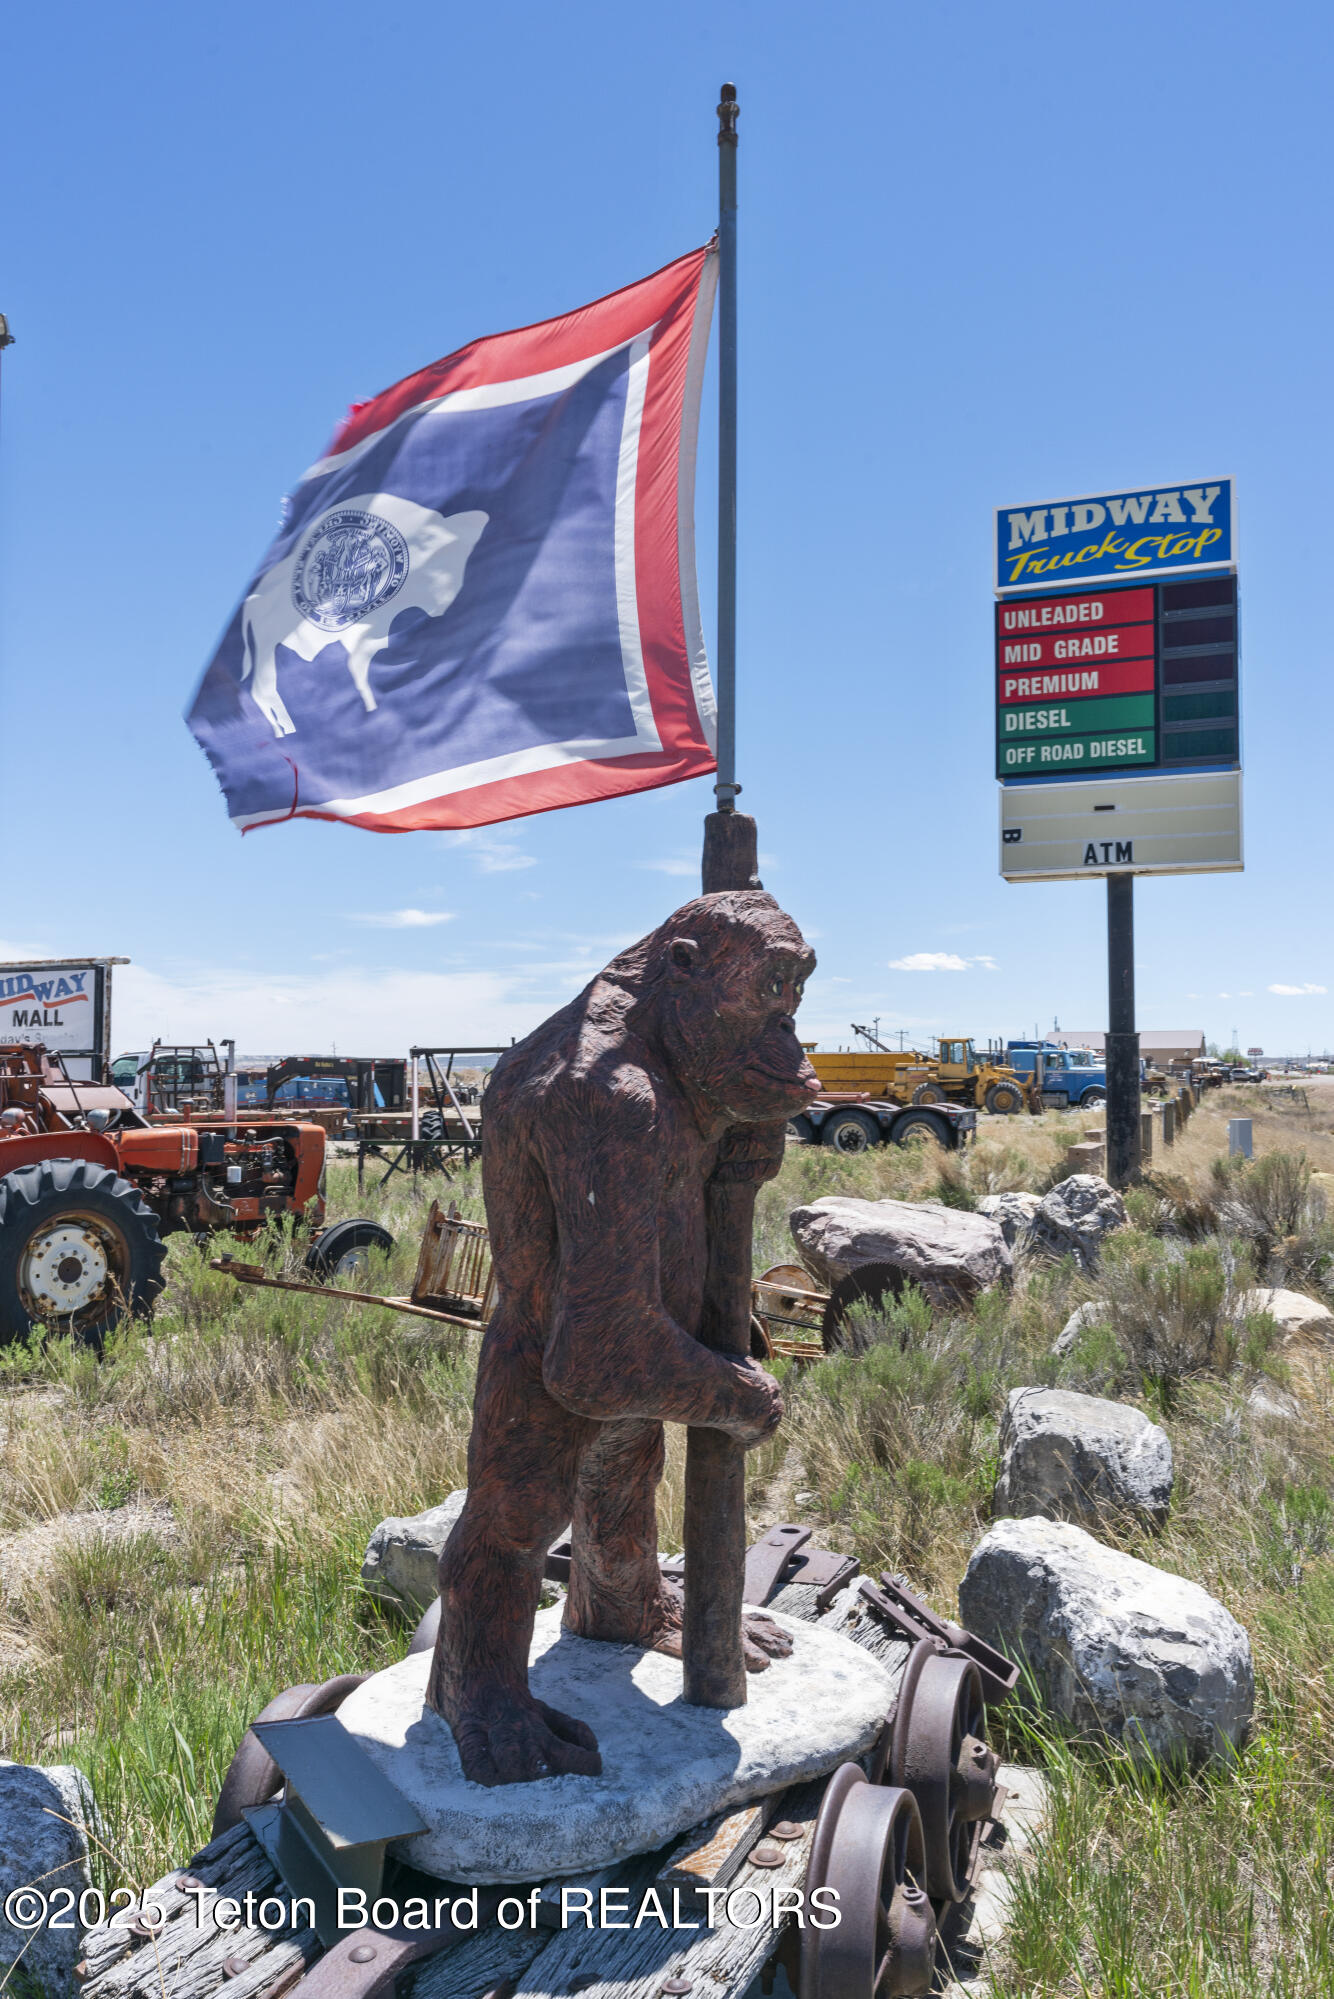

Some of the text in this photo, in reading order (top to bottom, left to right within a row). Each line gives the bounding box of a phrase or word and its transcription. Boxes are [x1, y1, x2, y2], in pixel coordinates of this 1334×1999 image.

[1008, 486, 1221, 550] MIDWAY
[1005, 528, 1222, 582] Truck Stop
[1004, 602, 1103, 629] UNLEADED
[1004, 635, 1119, 664] MID GRADE
[1004, 671, 1099, 697] PREMIUM
[1005, 709, 1071, 732] DIESEL
[1006, 738, 1146, 765] OFF ROAD DIESEL
[1084, 841, 1133, 864] ATM
[13, 1009, 64, 1027] MALL
